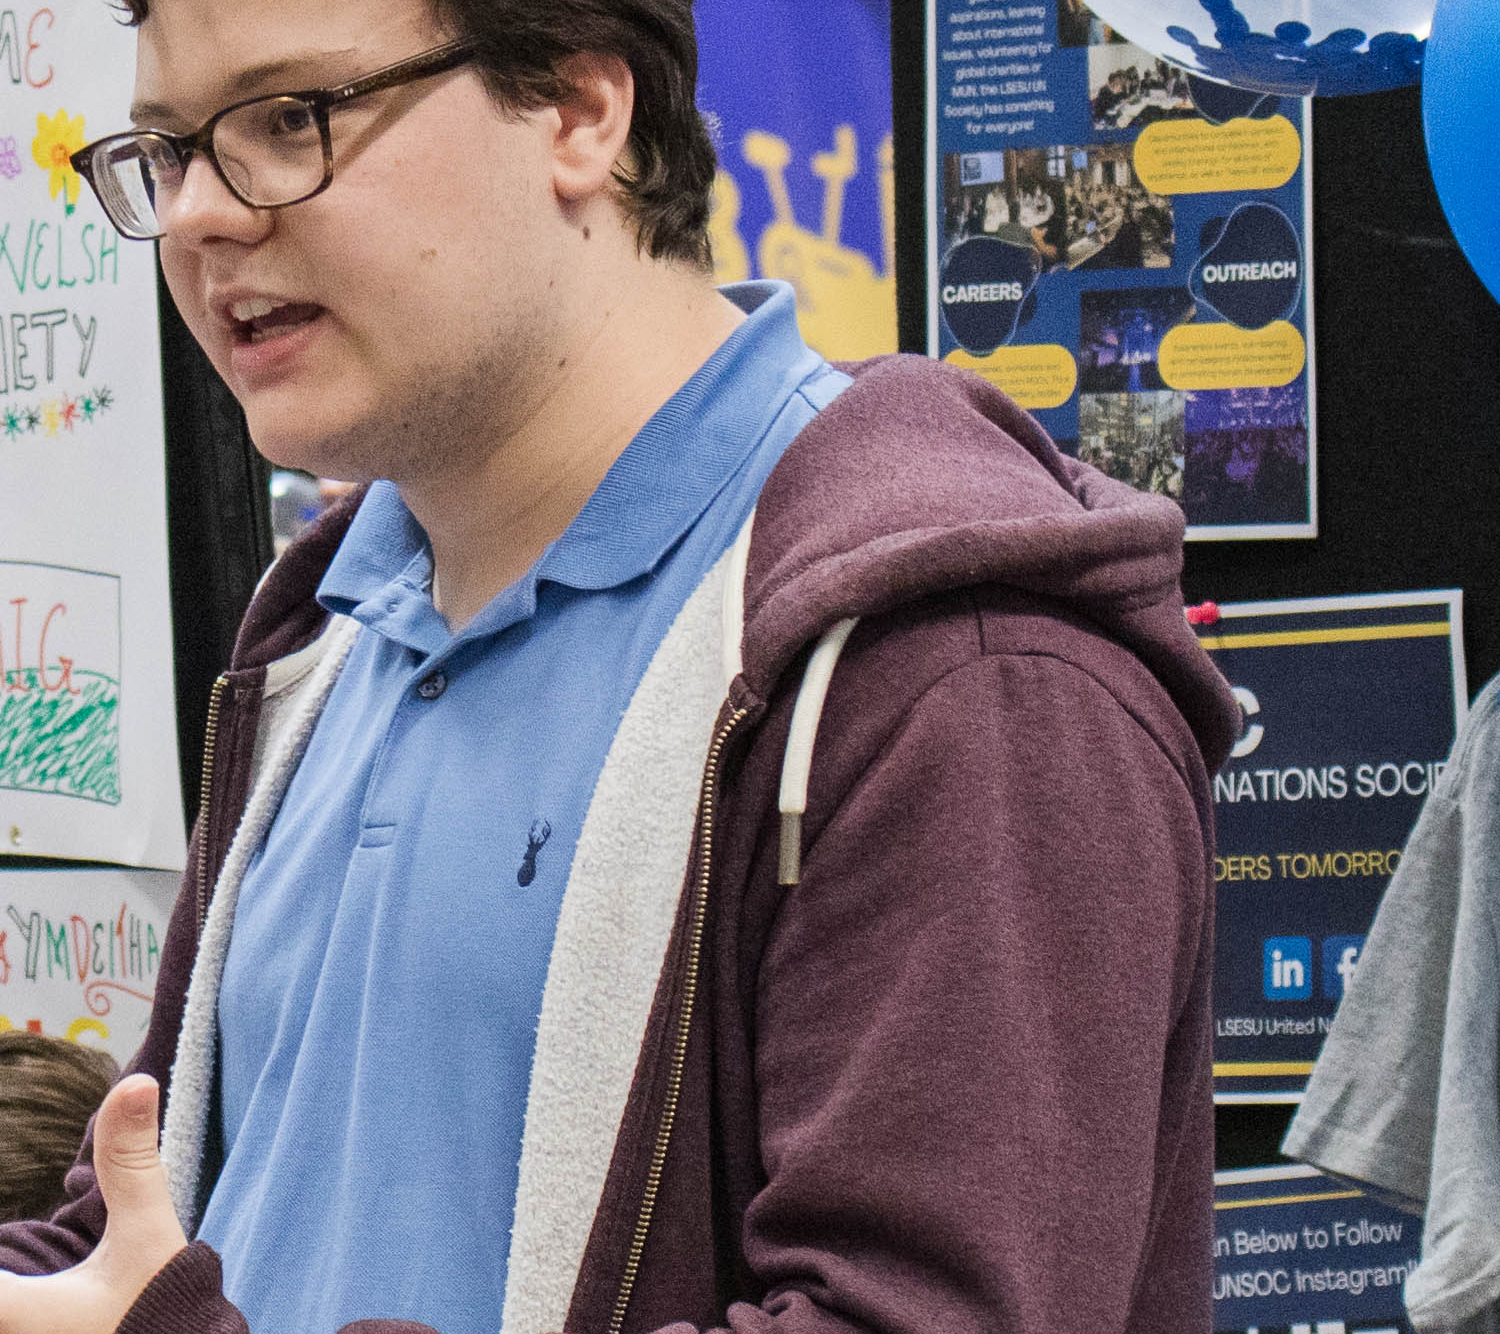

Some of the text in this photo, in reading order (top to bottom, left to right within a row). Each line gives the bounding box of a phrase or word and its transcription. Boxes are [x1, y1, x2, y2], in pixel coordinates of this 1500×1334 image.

[1203, 260, 1297, 284] OUTREACH
[943, 282, 1023, 304] CAREERS
[1213, 766, 1348, 803] NATIONS
[1217, 1018, 1263, 1037] LSESU
[1266, 1017, 1315, 1036] United
[1234, 1228, 1298, 1256] Below
[1302, 1225, 1329, 1250] to
[1333, 1219, 1402, 1247] Follow
[1212, 1269, 1291, 1301] UNSOC
